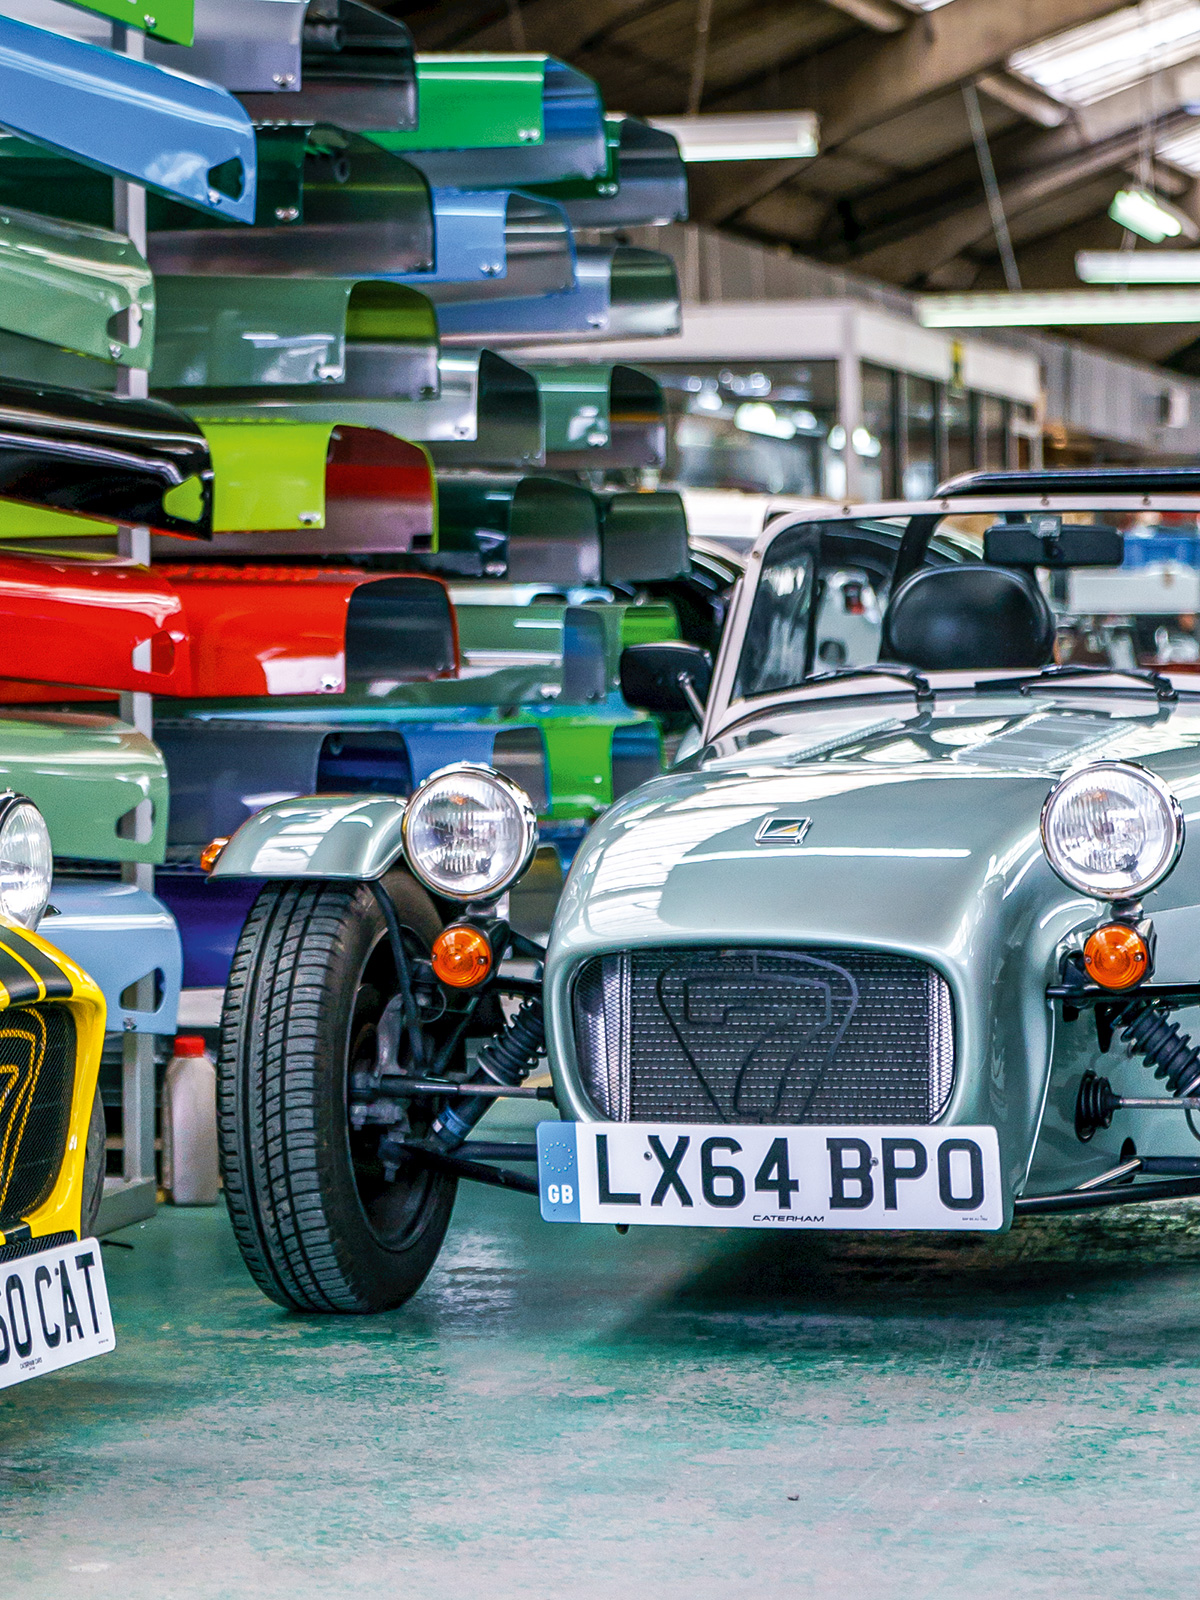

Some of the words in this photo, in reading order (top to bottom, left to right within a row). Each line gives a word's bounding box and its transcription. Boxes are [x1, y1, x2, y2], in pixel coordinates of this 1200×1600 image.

[547, 1184, 574, 1205] GB
[595, 1133, 800, 1210] LX64
[826, 1137, 986, 1211] BPO
[752, 1214, 825, 1223] CATERHAM
[34, 1251, 101, 1349] CAT
